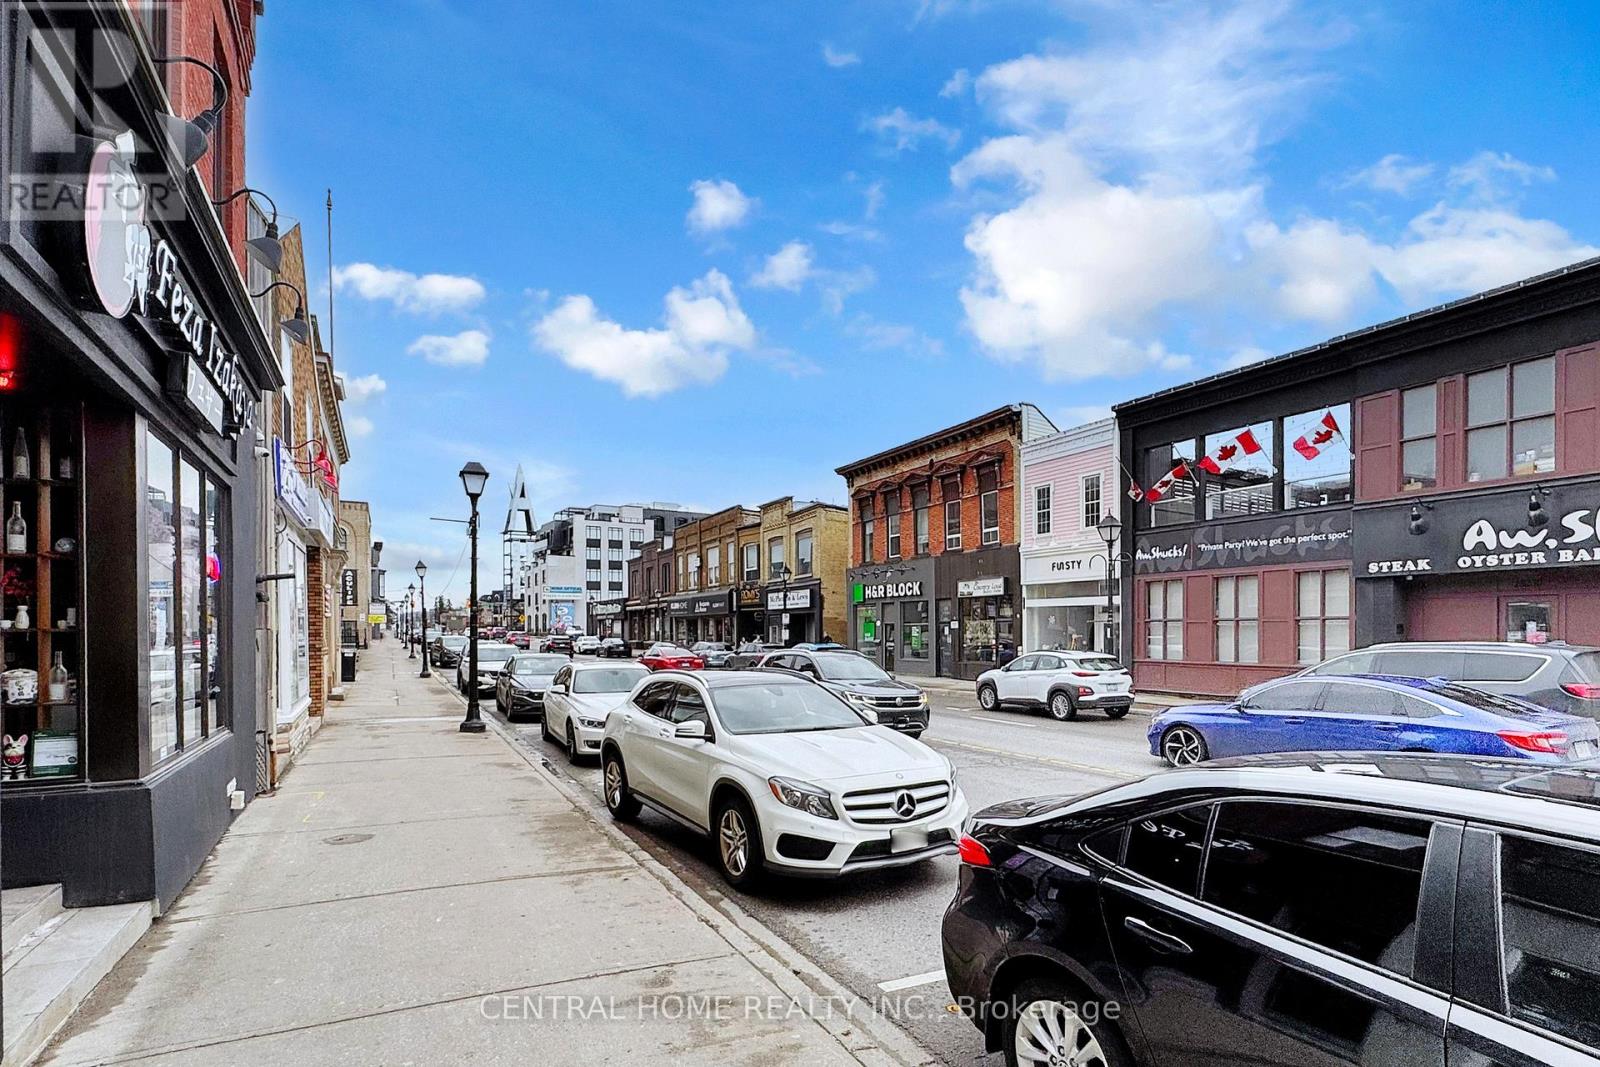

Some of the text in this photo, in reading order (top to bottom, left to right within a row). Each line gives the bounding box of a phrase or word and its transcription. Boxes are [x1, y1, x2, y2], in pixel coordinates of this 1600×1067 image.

[156, 239, 253, 436] Feza Izakaya
[1269, 538, 1282, 547] got
[1283, 536, 1296, 544] the
[1297, 533, 1326, 544] perfect
[1368, 559, 1431, 573] STEAK
[1457, 552, 1547, 568] OYSTER
[866, 581, 921, 599] H&R BLOCK
